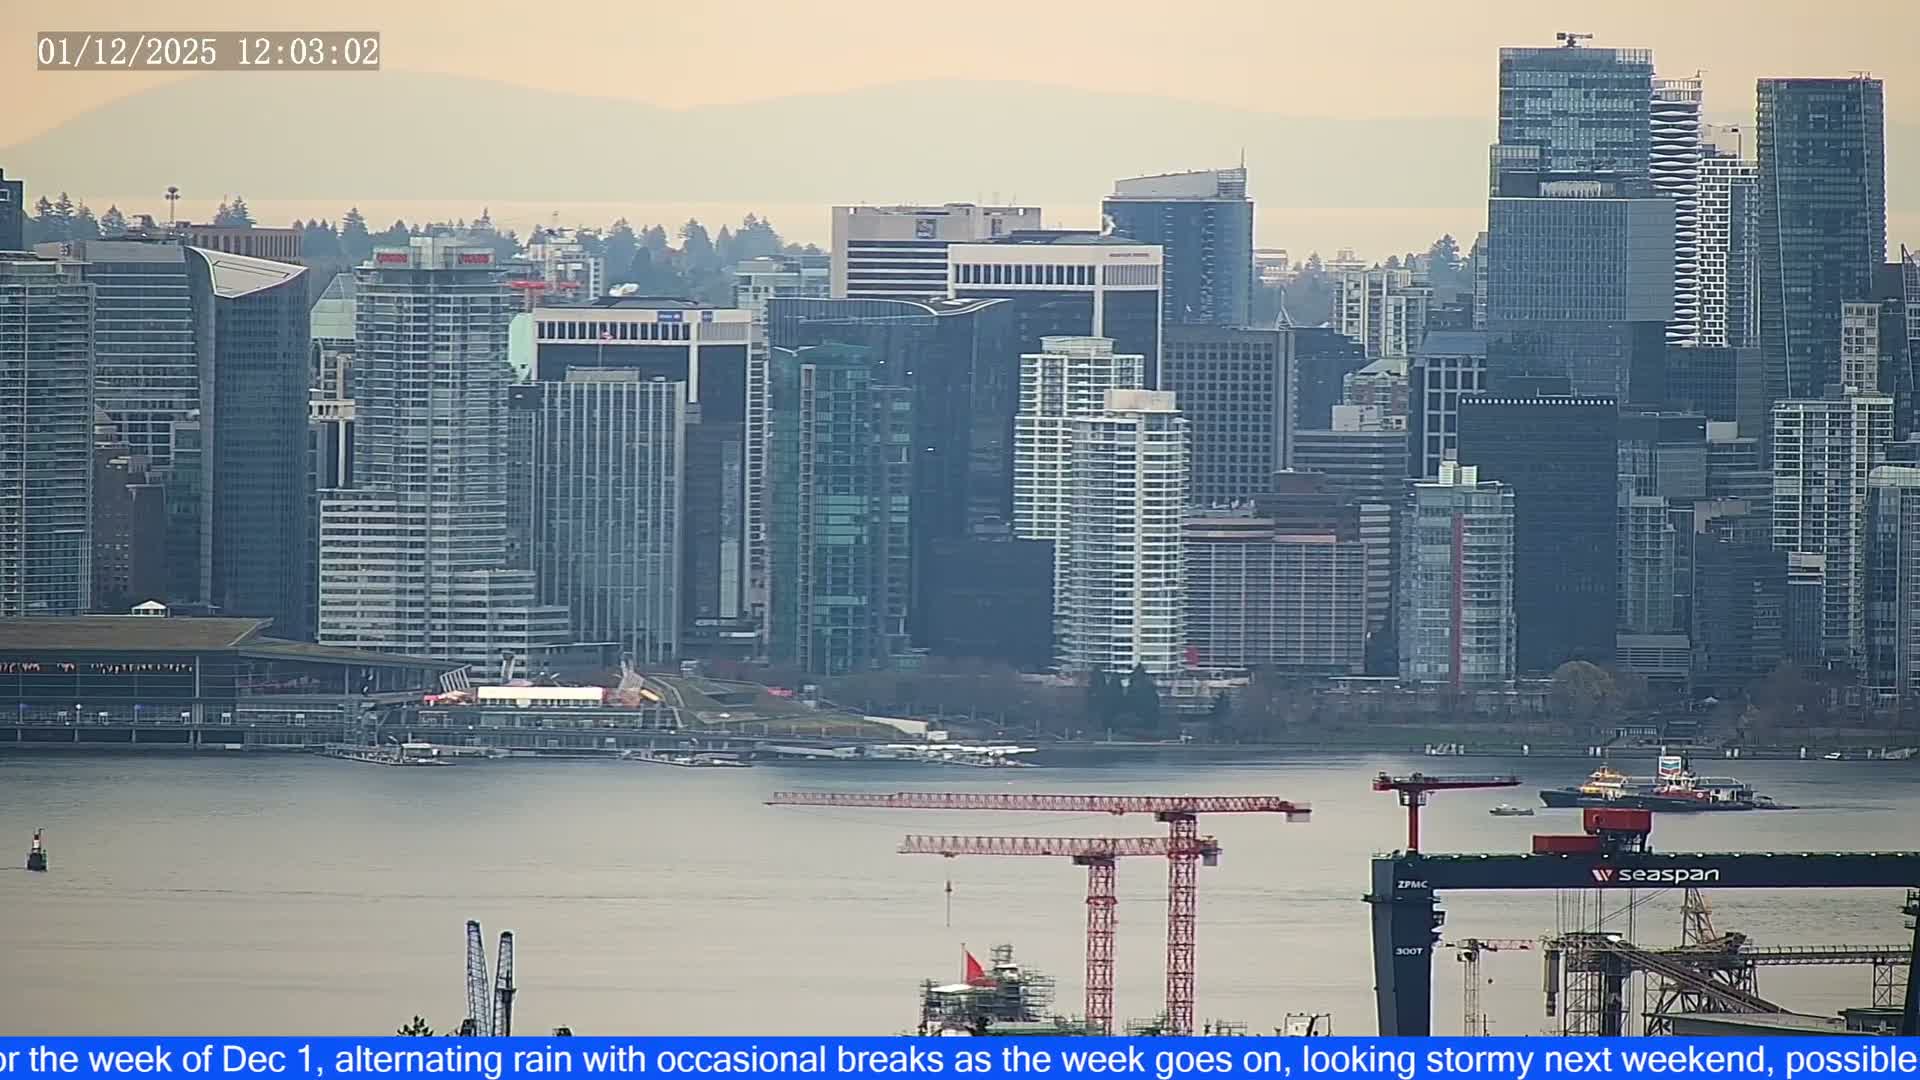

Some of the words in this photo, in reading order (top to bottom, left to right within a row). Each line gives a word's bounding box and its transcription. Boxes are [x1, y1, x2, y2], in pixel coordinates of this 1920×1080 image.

[1618, 868, 1719, 885] seaspan
[1397, 880, 1428, 889] ZPMC
[1395, 947, 1423, 955] 300T
